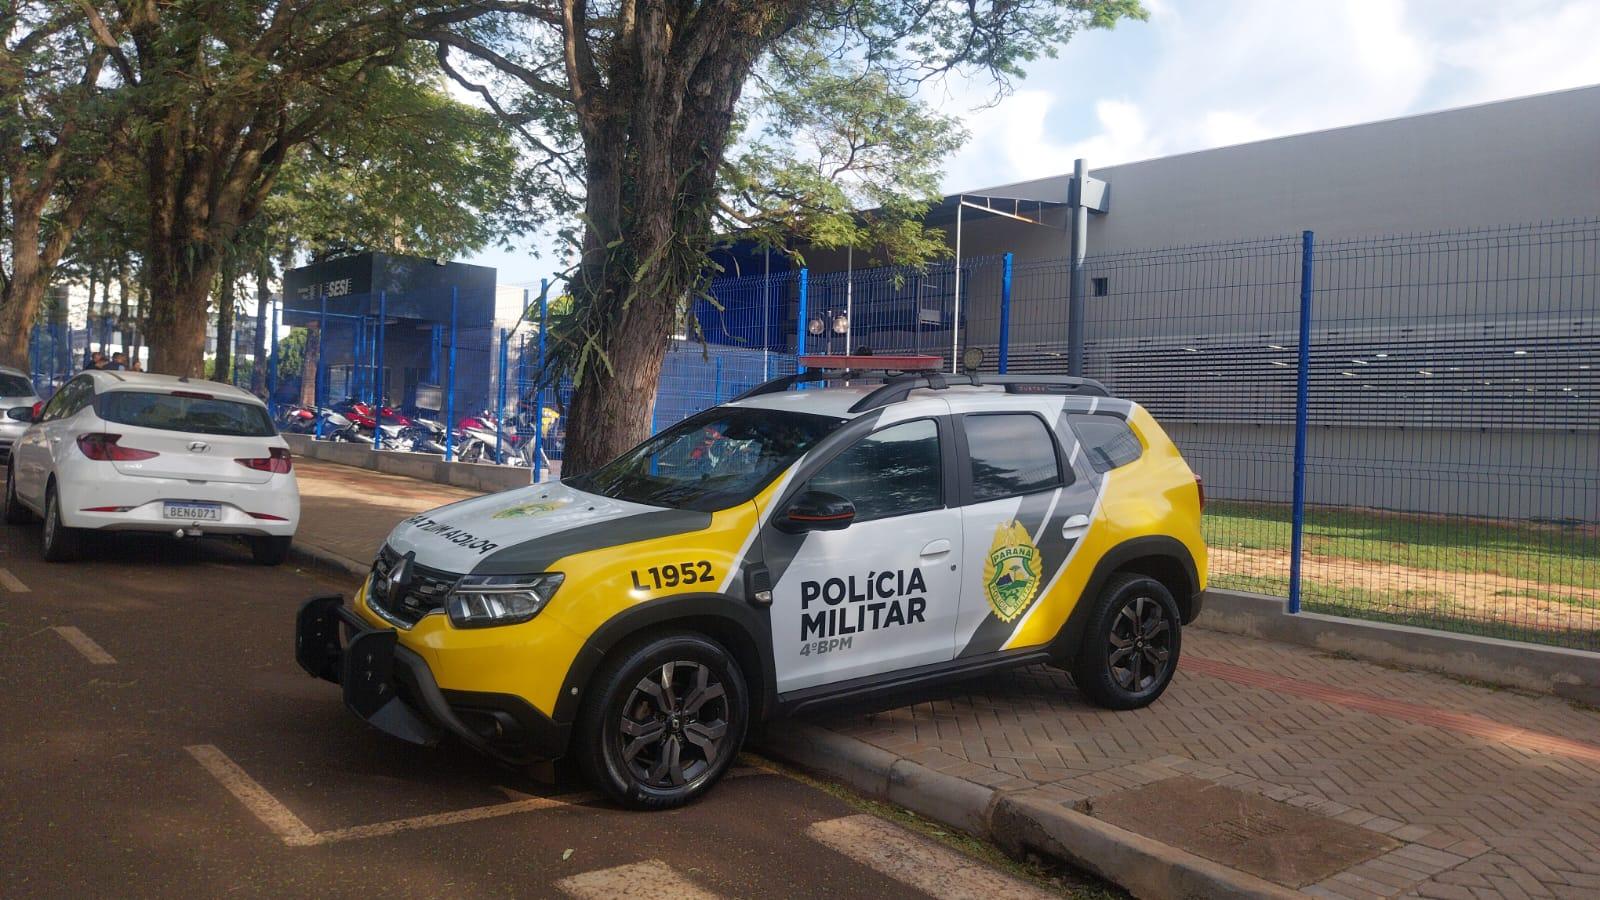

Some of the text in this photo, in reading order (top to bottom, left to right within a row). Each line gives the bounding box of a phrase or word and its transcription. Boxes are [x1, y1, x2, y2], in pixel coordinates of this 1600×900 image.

[328, 279, 350, 298] SESI
[170, 507, 216, 518] BEN6D71
[631, 560, 715, 591] L1952
[801, 597, 927, 642] MILITAR
